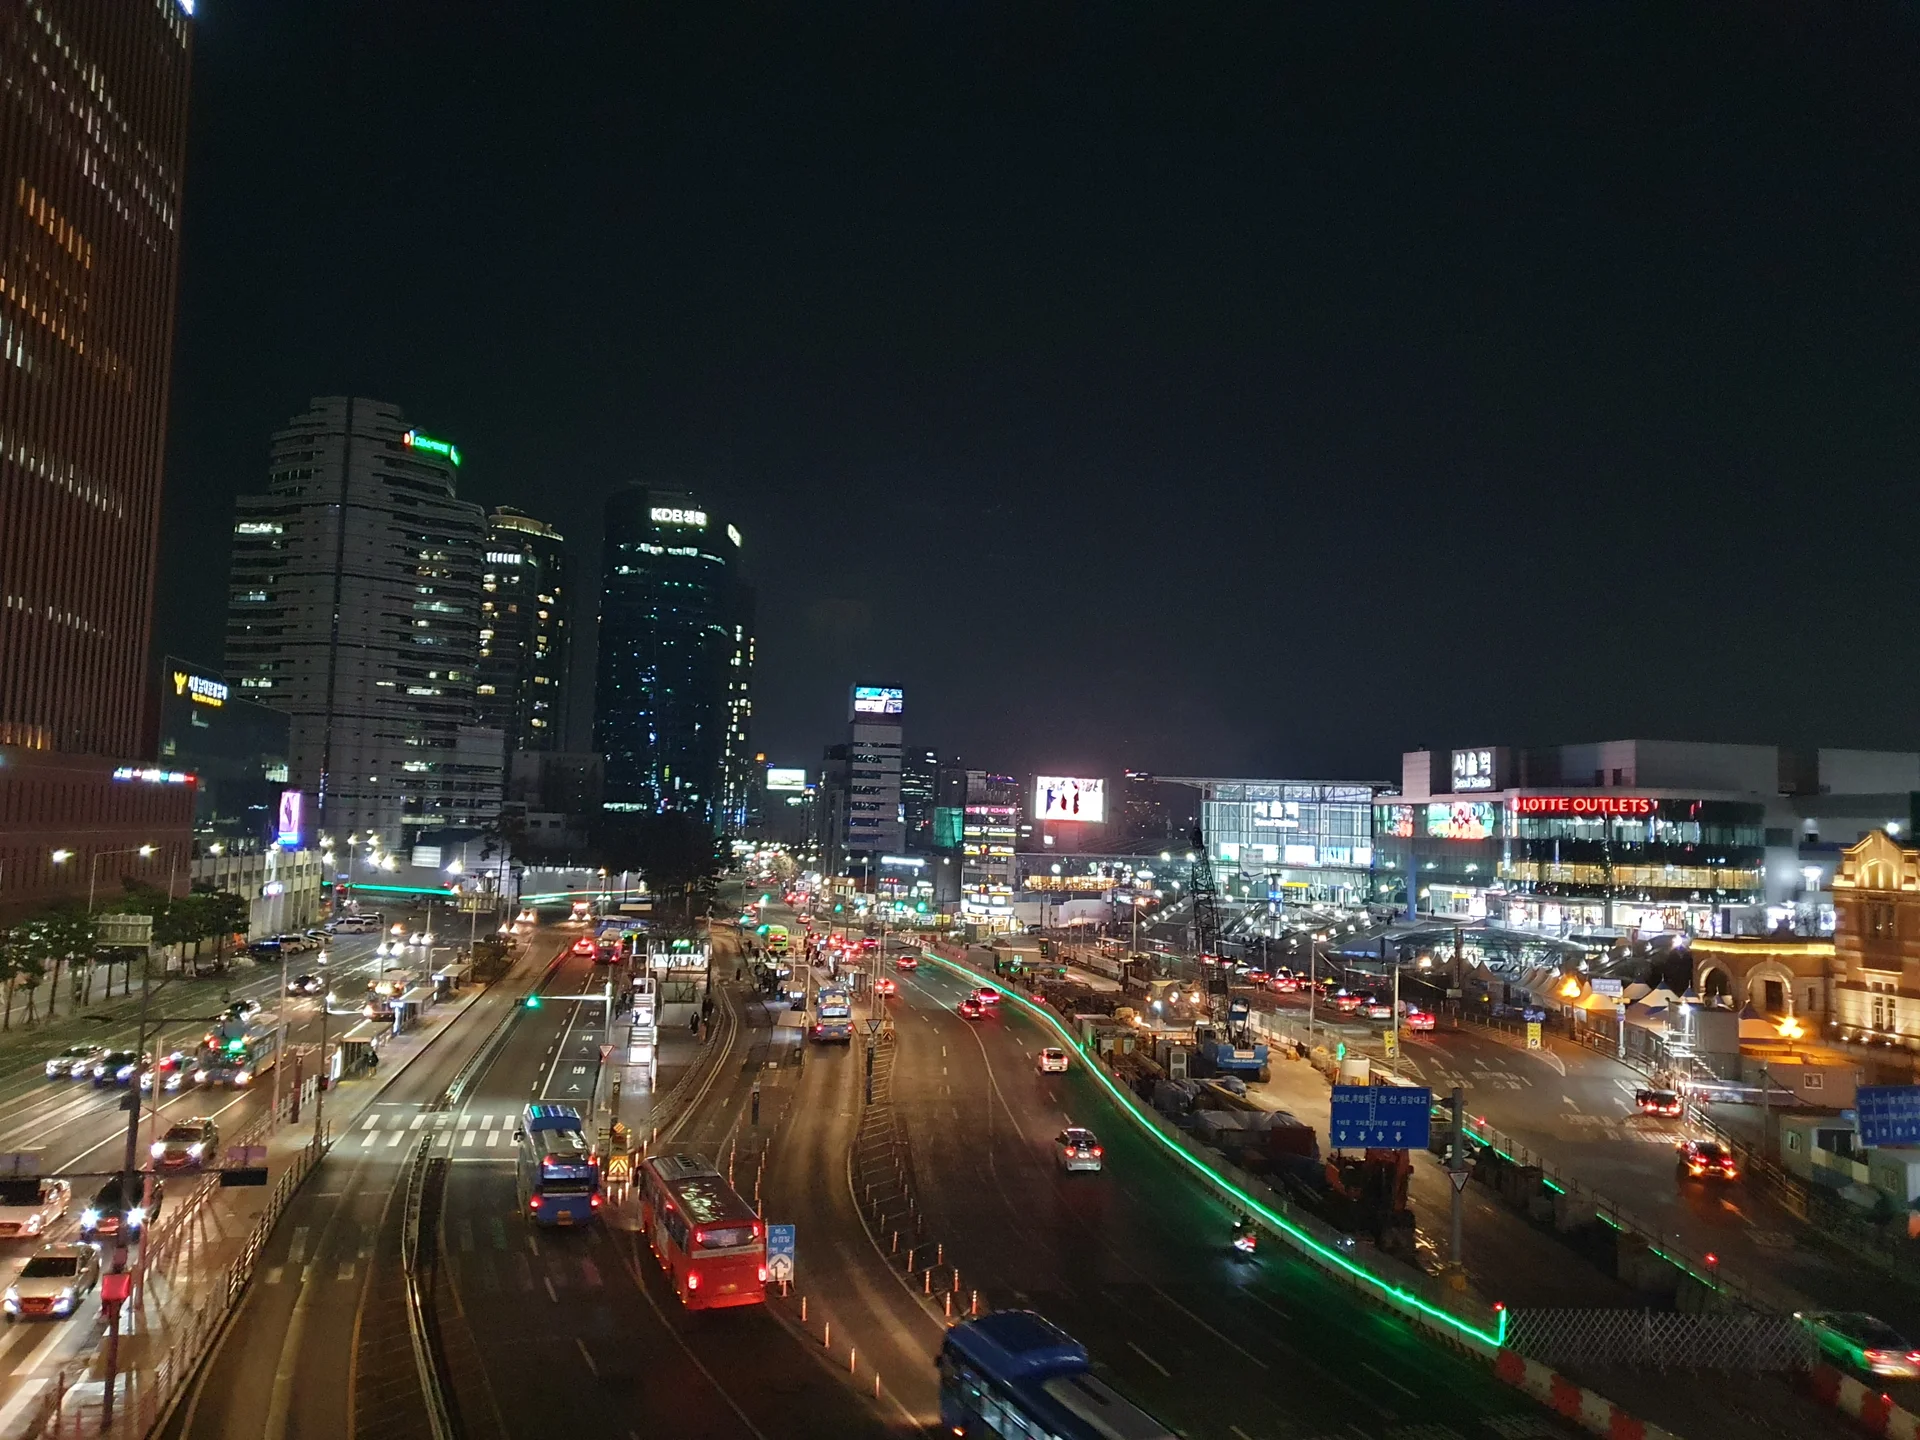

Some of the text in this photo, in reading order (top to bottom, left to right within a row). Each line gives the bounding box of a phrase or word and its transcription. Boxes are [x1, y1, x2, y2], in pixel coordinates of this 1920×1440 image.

[651, 508, 707, 526] KDB생명
[1453, 751, 1491, 776] 서울역
[1454, 776, 1492, 788] Seoul Station
[1522, 798, 1650, 813] LOTTE OUTLETS
